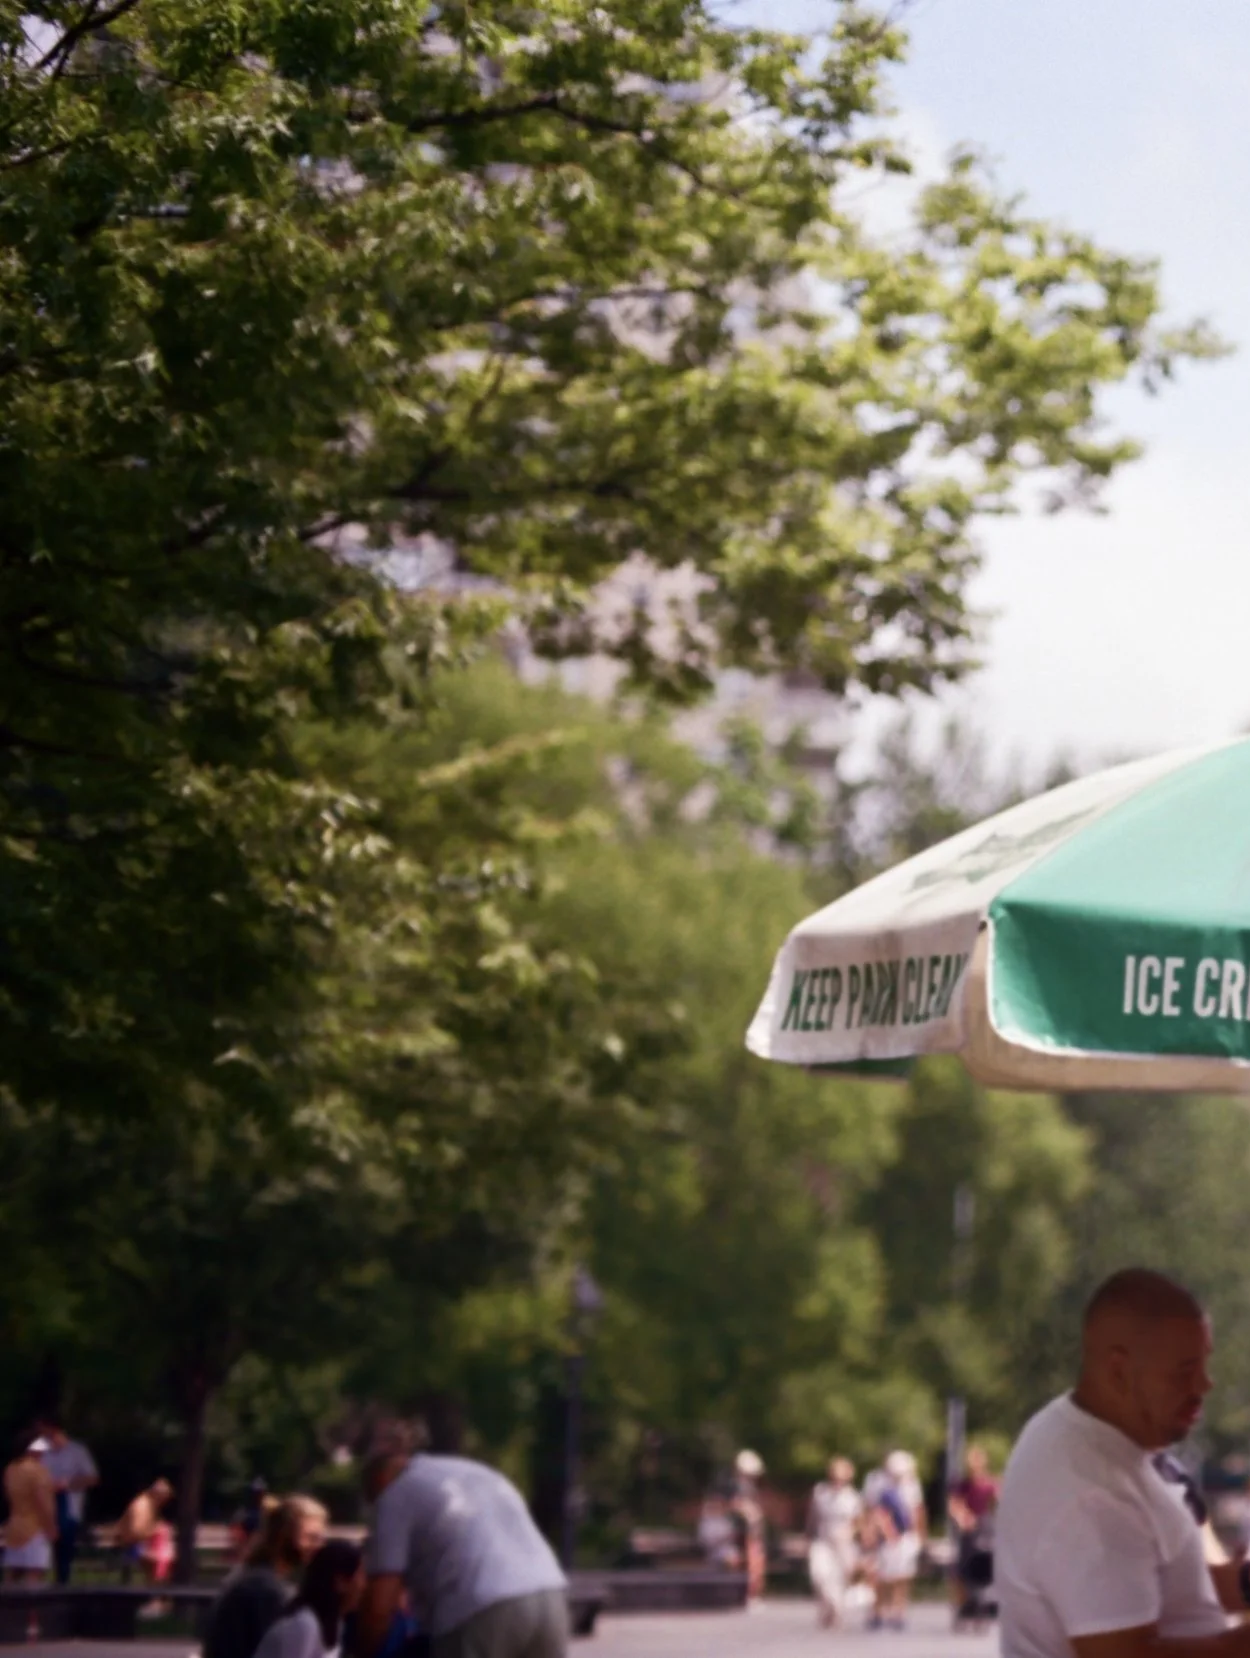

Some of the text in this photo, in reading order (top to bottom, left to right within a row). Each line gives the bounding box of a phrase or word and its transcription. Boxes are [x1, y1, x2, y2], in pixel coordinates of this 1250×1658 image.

[780, 965, 843, 1031] KEEP
[845, 959, 900, 1029] PARK
[1123, 955, 1186, 1017] ICE
